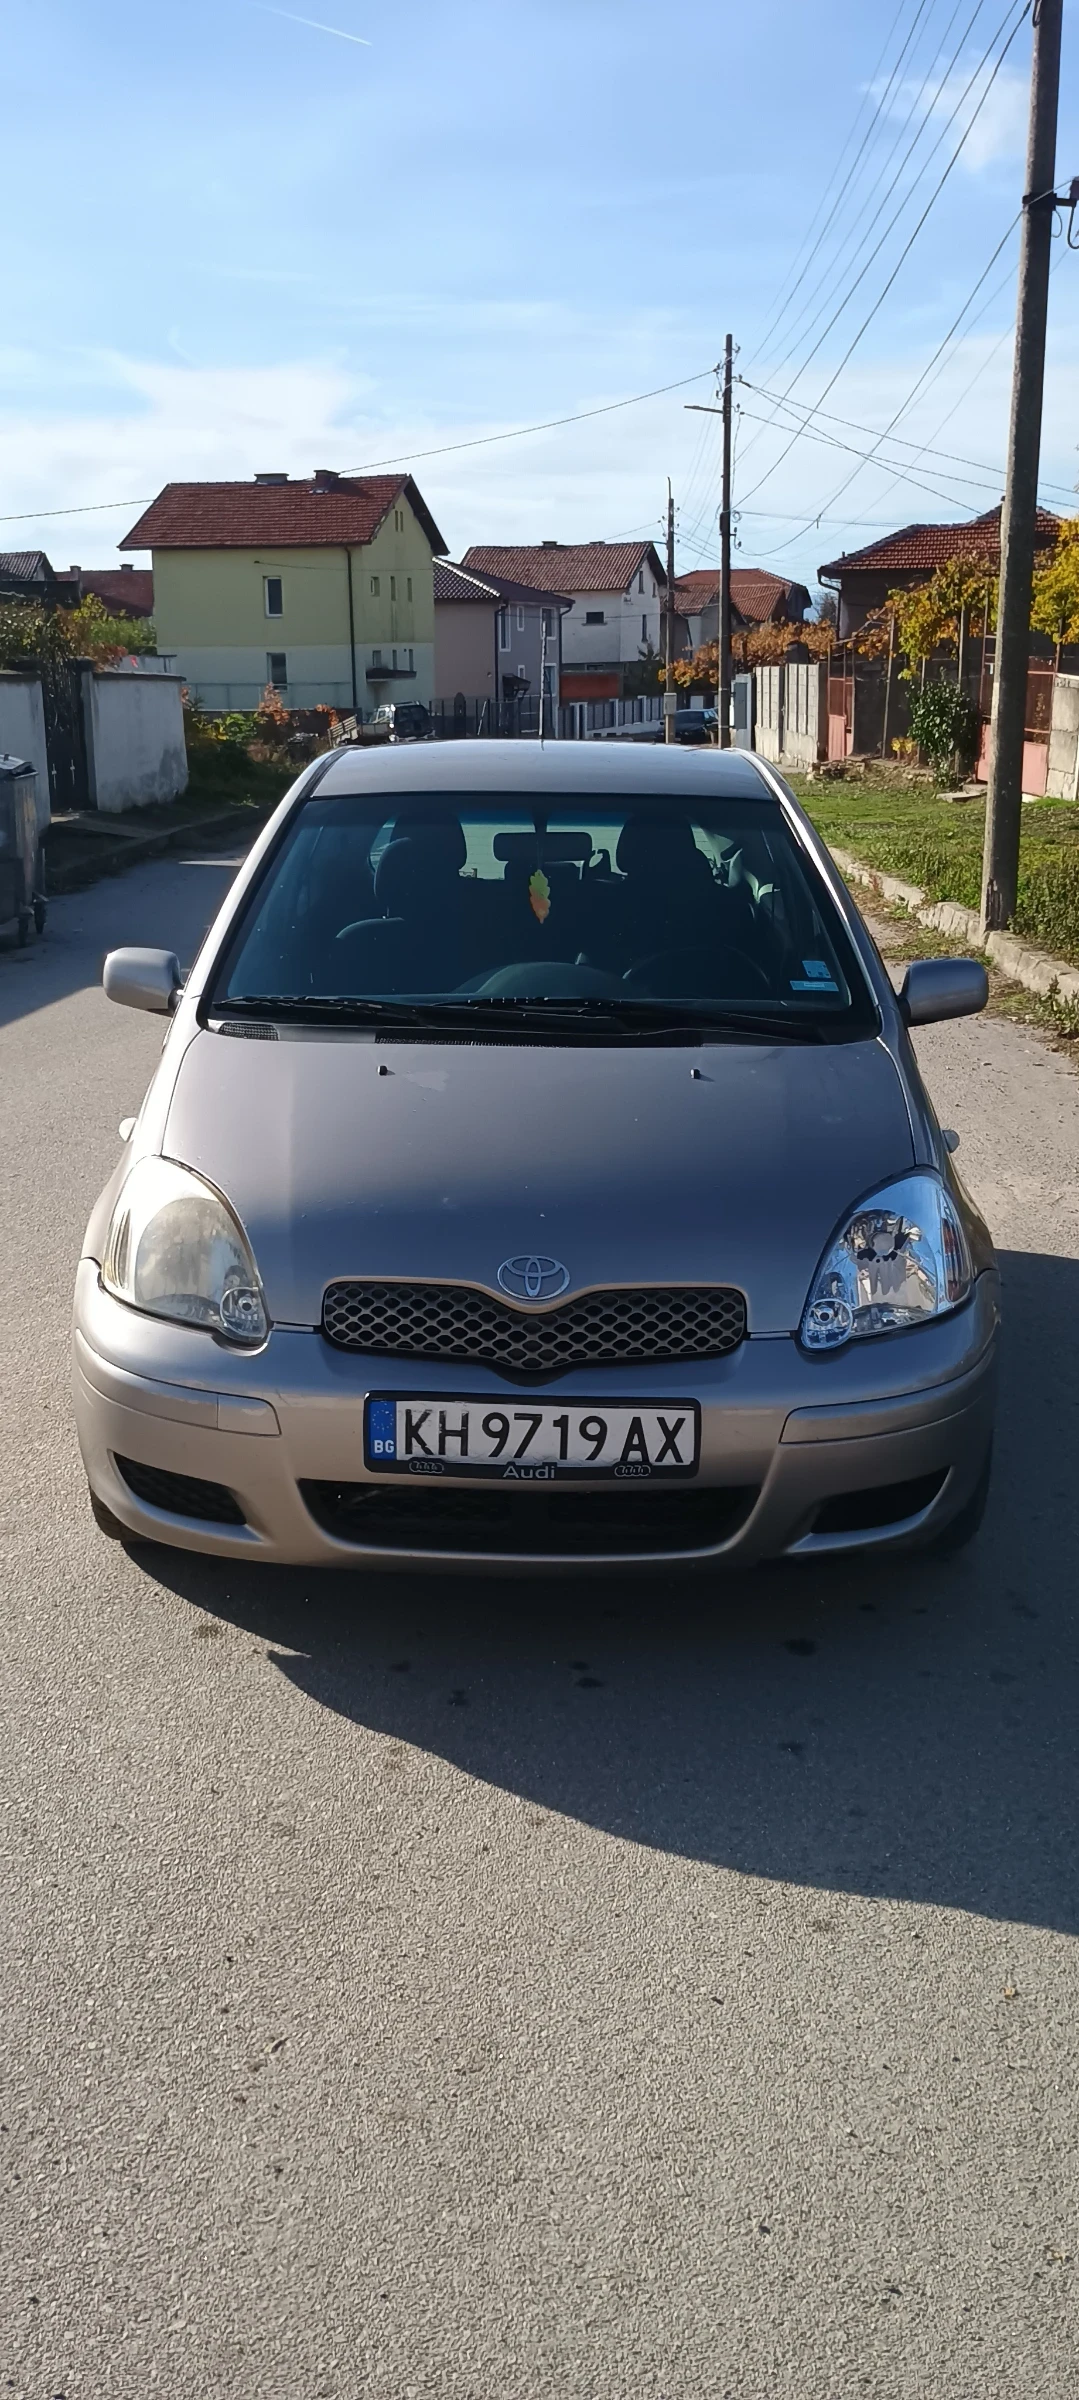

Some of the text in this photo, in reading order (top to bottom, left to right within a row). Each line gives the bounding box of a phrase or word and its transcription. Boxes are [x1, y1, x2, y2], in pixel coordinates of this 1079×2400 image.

[481, 1411, 608, 1461] 9719
[619, 1416, 686, 1463] AX
[374, 1440, 395, 1454] BG
[502, 1465, 555, 1479] Audi
